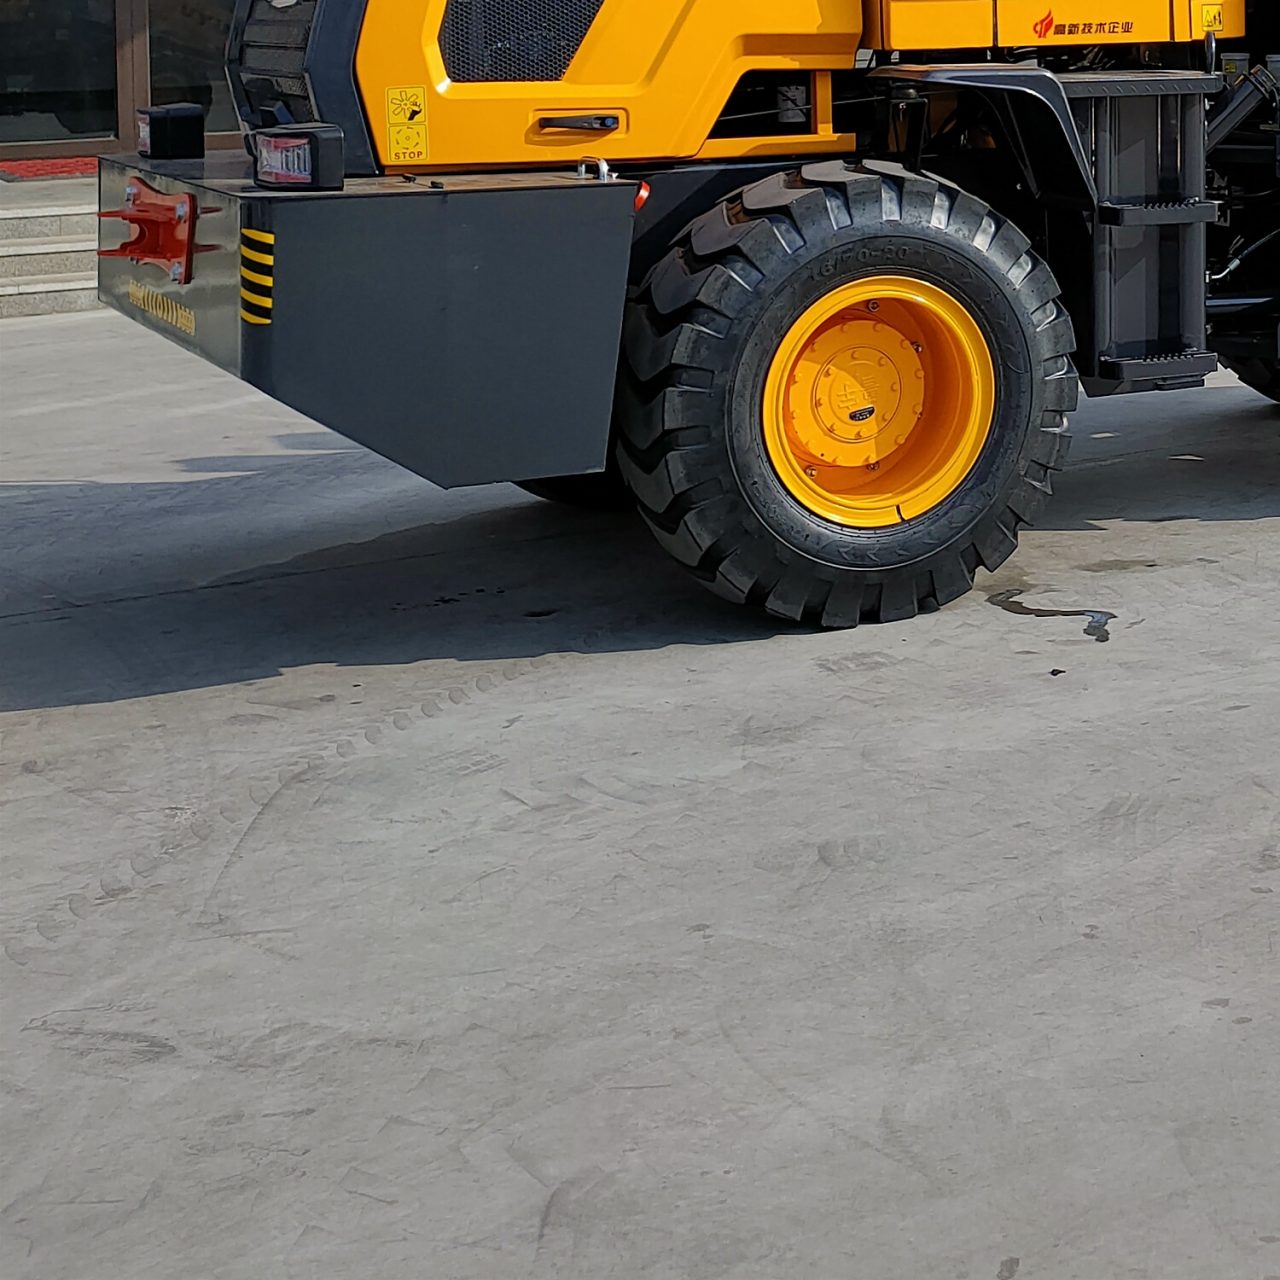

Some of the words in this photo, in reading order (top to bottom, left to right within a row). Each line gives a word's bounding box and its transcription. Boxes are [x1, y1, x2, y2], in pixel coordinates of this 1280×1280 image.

[1053, 21, 1134, 35] 高新技术企业
[394, 150, 423, 160] STOP
